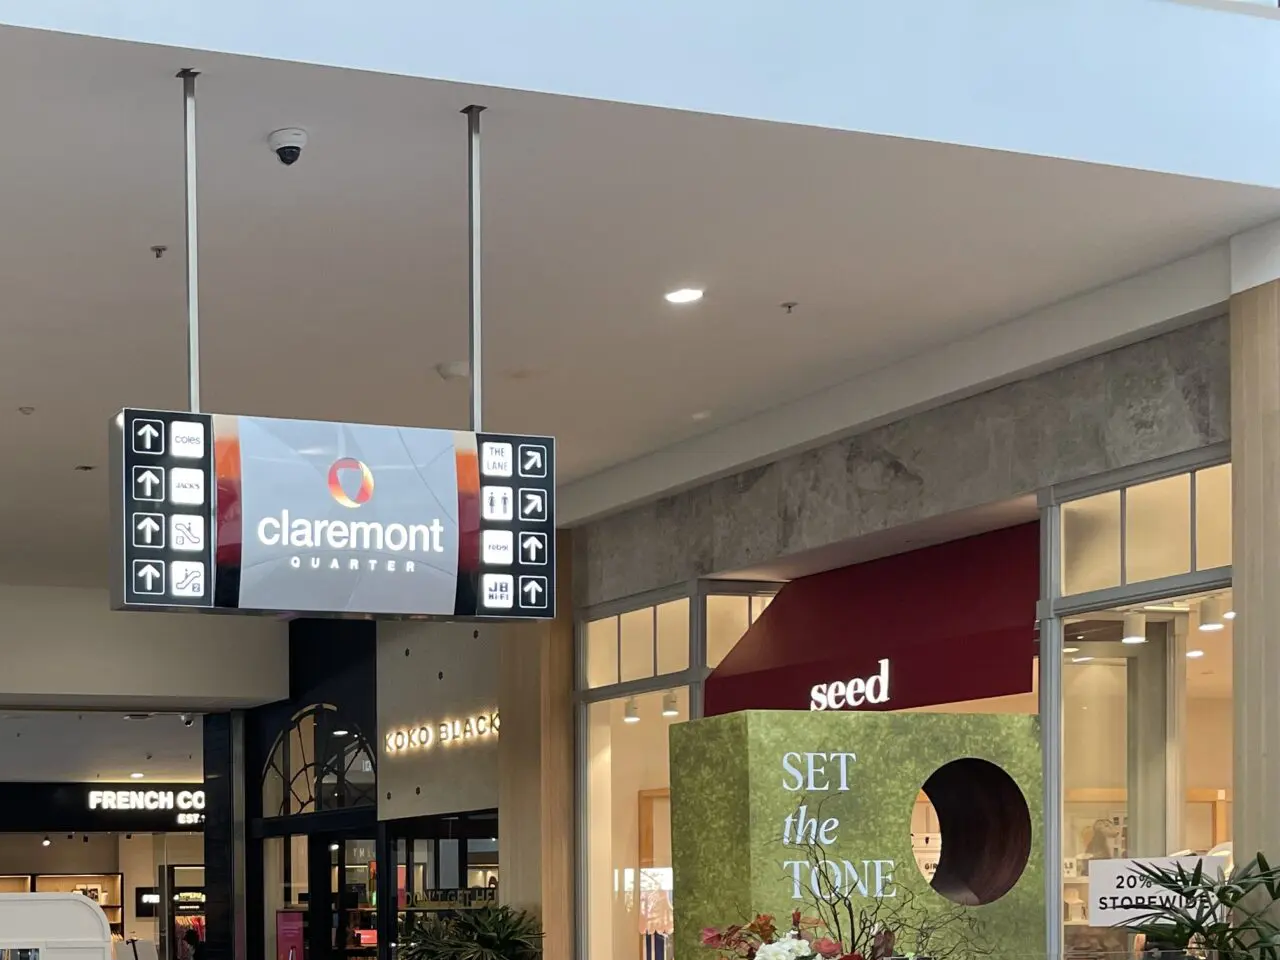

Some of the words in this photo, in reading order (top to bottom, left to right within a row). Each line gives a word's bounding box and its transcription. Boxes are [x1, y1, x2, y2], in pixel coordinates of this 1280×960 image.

[175, 435, 201, 445] coles
[489, 447, 505, 456] THE
[487, 460, 508, 471] LANE
[257, 509, 444, 552] claremont
[291, 556, 416, 572] QUARTER
[488, 582, 509, 593] JB
[810, 658, 890, 711] seed
[384, 726, 430, 752] KOKO
[439, 711, 500, 741] BLACK
[782, 751, 857, 791] SET
[89, 790, 174, 810] FRENCH
[177, 790, 206, 810] CO
[783, 805, 840, 845] the
[783, 859, 897, 900] TONE
[1116, 874, 1153, 889] 20%
